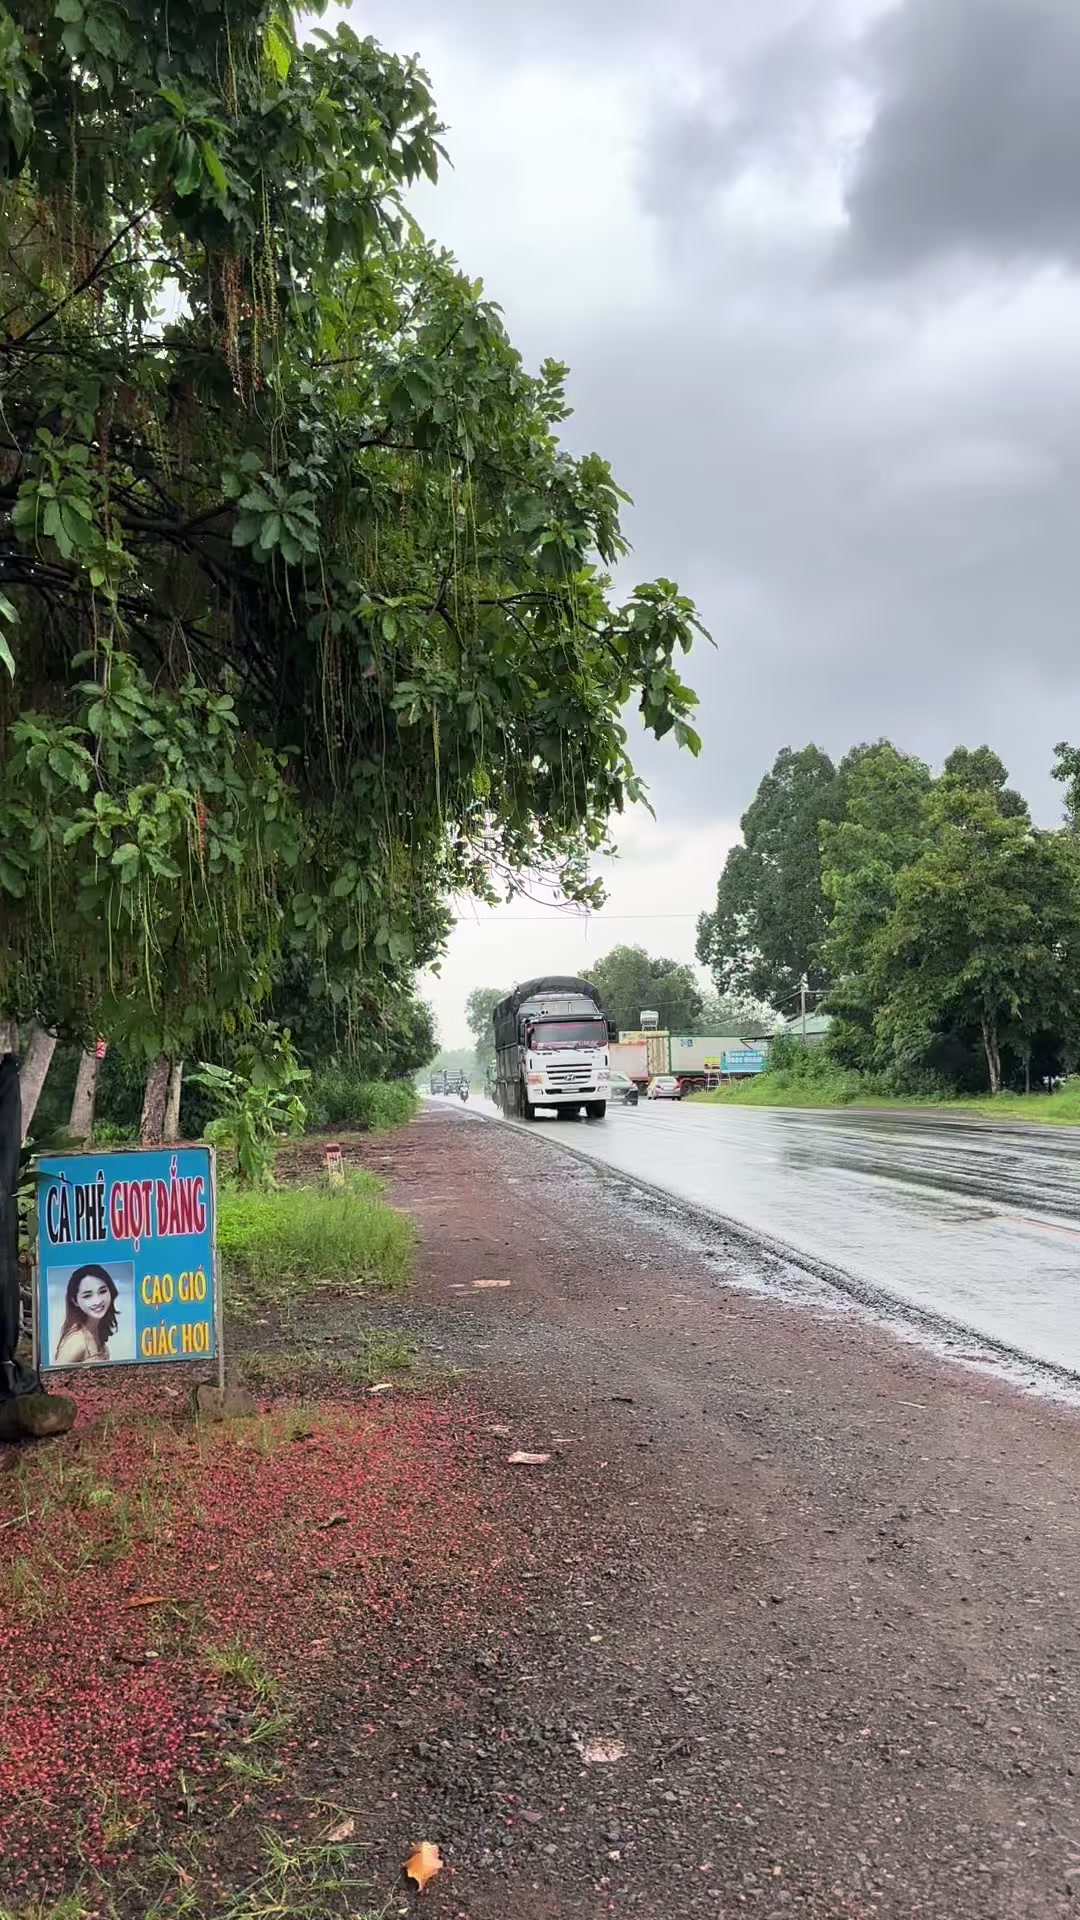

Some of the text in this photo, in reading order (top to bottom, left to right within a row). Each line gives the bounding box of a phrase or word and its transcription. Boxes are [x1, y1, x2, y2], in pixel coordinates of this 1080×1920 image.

[46, 1155, 207, 1252] CÀ PHÊ GIỌT ĐẮNG
[141, 1264, 207, 1311] CẠO GIÓ
[141, 1319, 210, 1357] GIÁC HƠI
